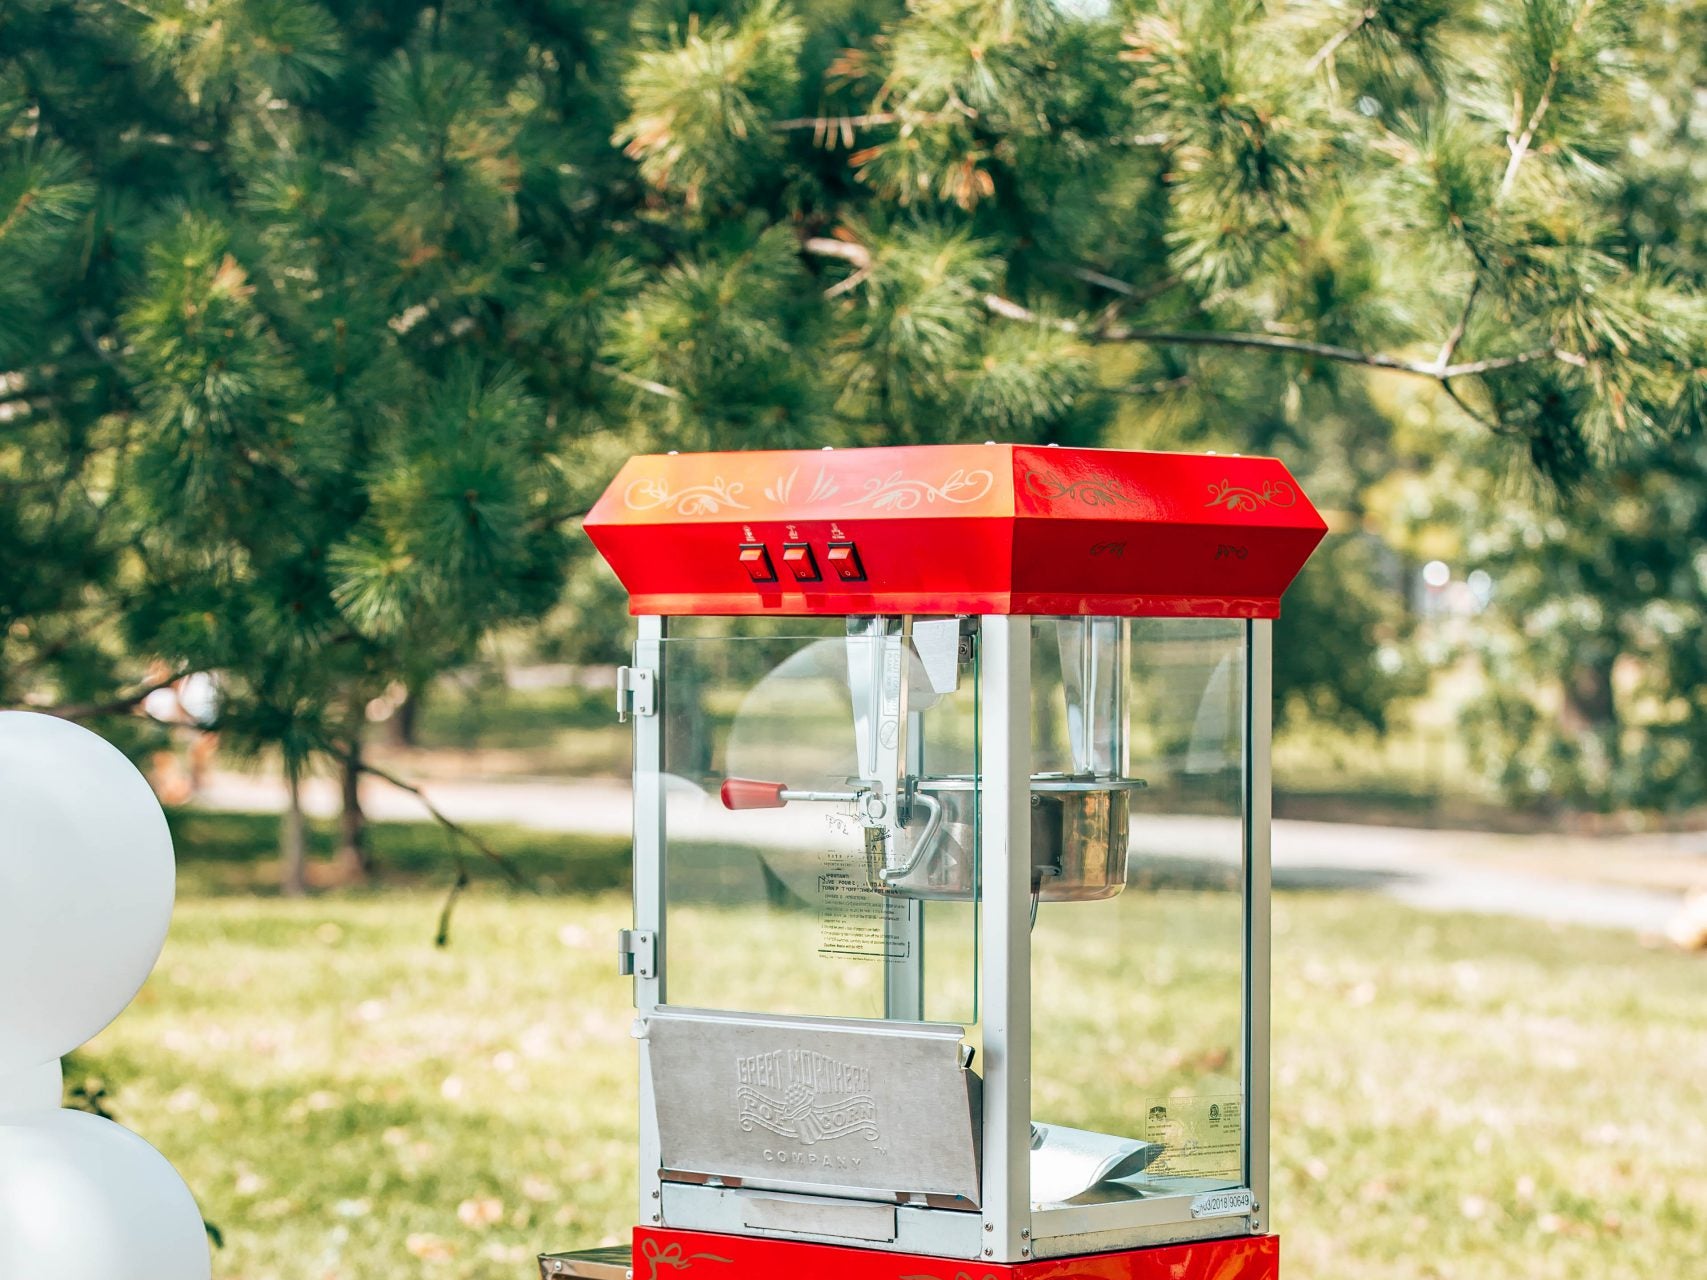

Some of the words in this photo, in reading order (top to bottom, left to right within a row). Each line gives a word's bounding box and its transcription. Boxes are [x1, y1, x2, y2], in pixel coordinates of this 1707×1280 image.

[737, 1049, 783, 1090] GREAT
[787, 1049, 872, 1095] NORTHERN
[763, 1149, 862, 1170] COMPANY
